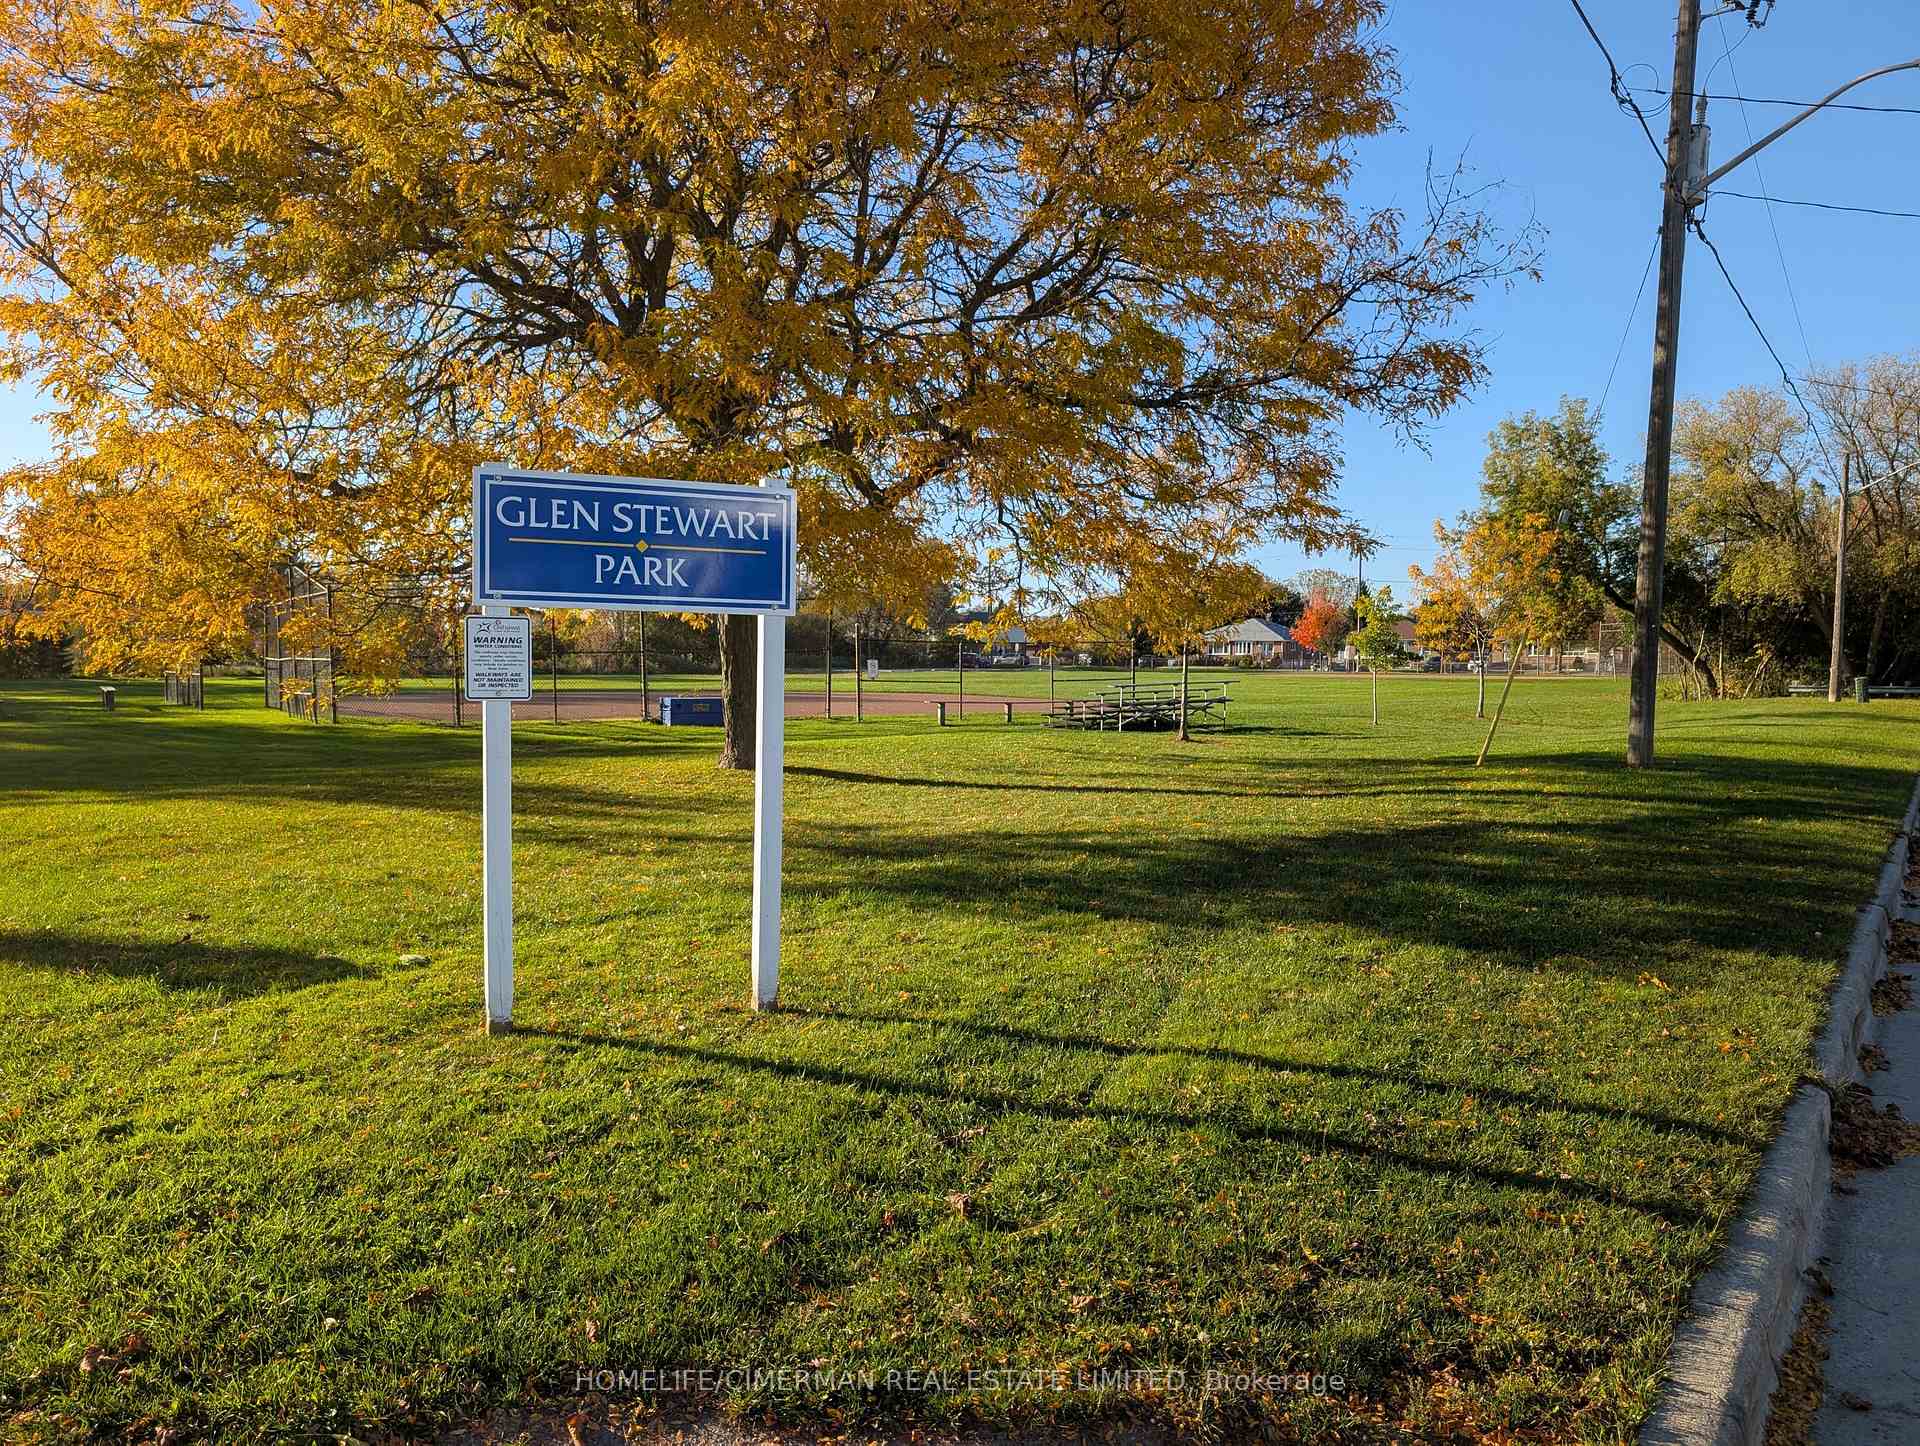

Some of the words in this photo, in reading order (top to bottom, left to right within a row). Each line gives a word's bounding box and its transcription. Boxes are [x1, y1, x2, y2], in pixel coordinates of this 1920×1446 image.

[496, 495, 600, 532] GLEN
[612, 503, 777, 541] STEWART
[594, 554, 689, 588] PARK
[473, 636, 523, 644] WARNING
